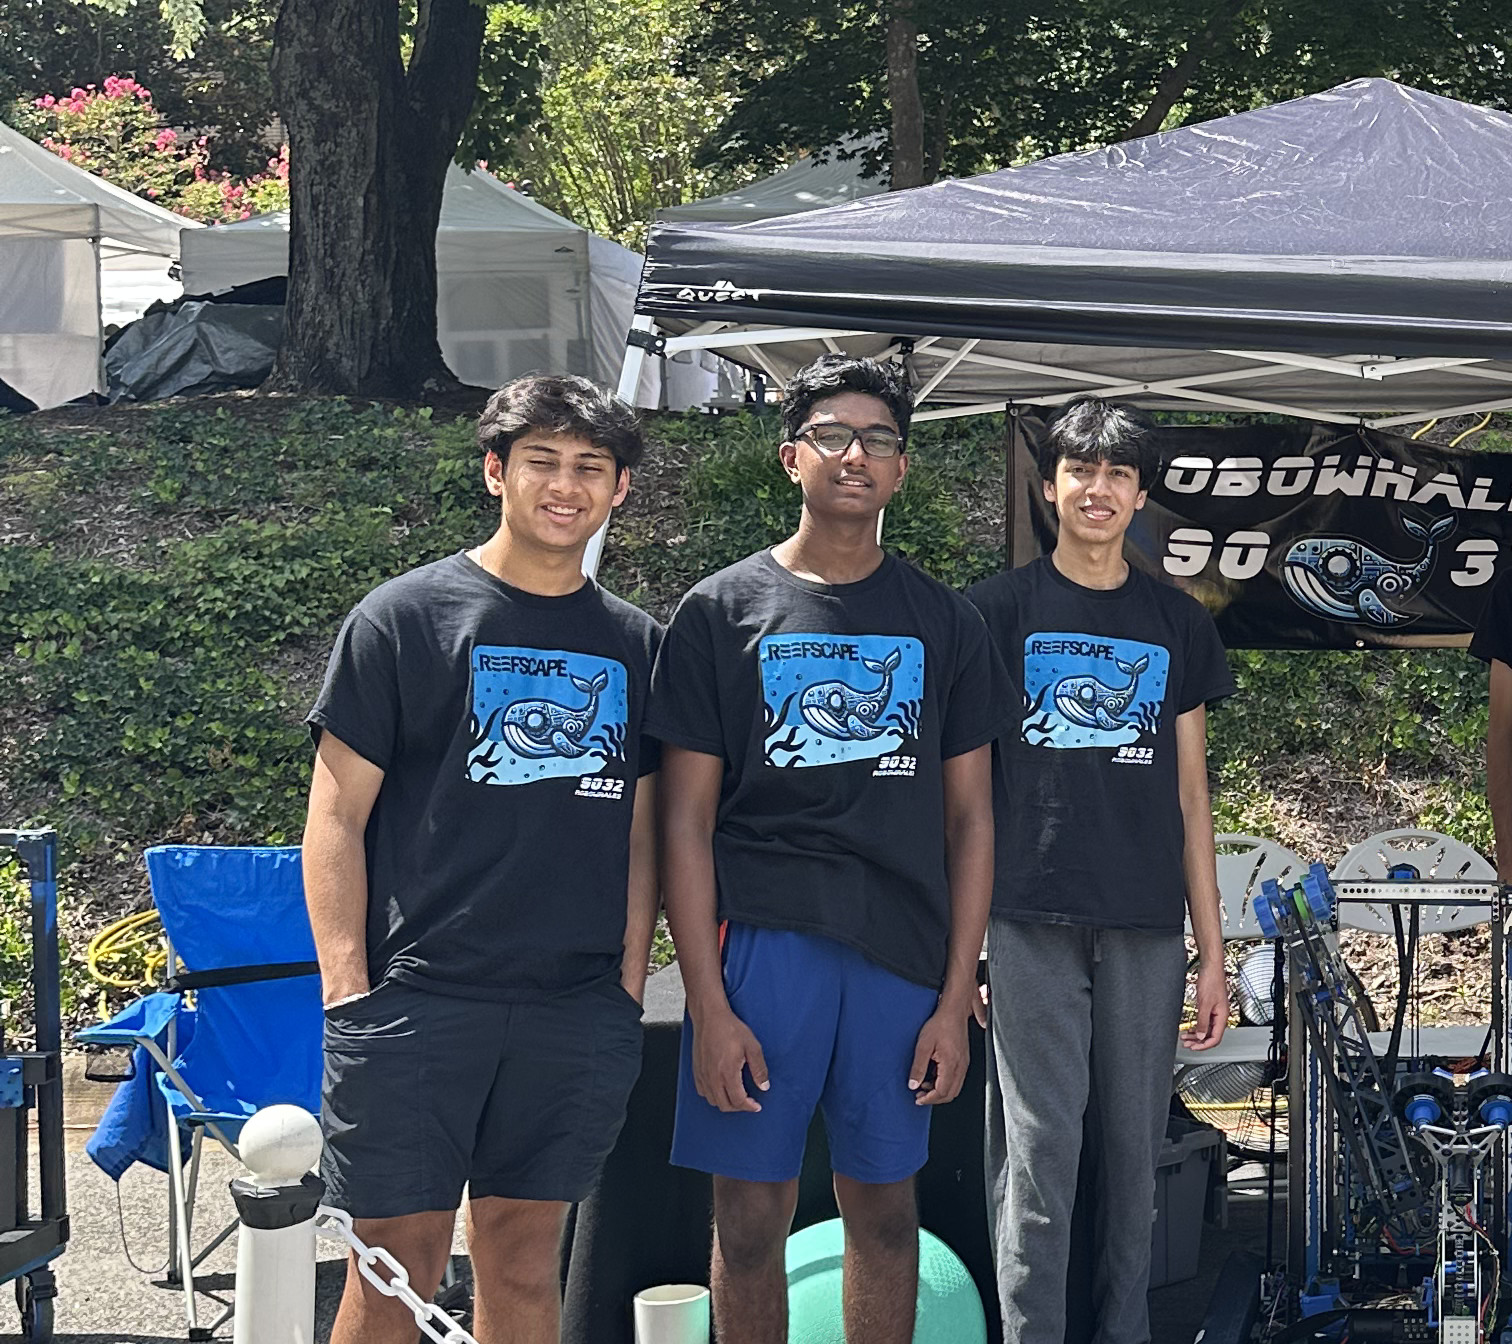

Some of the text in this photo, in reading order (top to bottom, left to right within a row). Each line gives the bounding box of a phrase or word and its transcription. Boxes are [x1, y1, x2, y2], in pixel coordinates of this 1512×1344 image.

[1162, 528, 1271, 580] 90
[766, 641, 860, 662] REEFSCAPE
[1031, 640, 1115, 661] REEFSCAPE
[478, 654, 568, 677] REEFSCAPE
